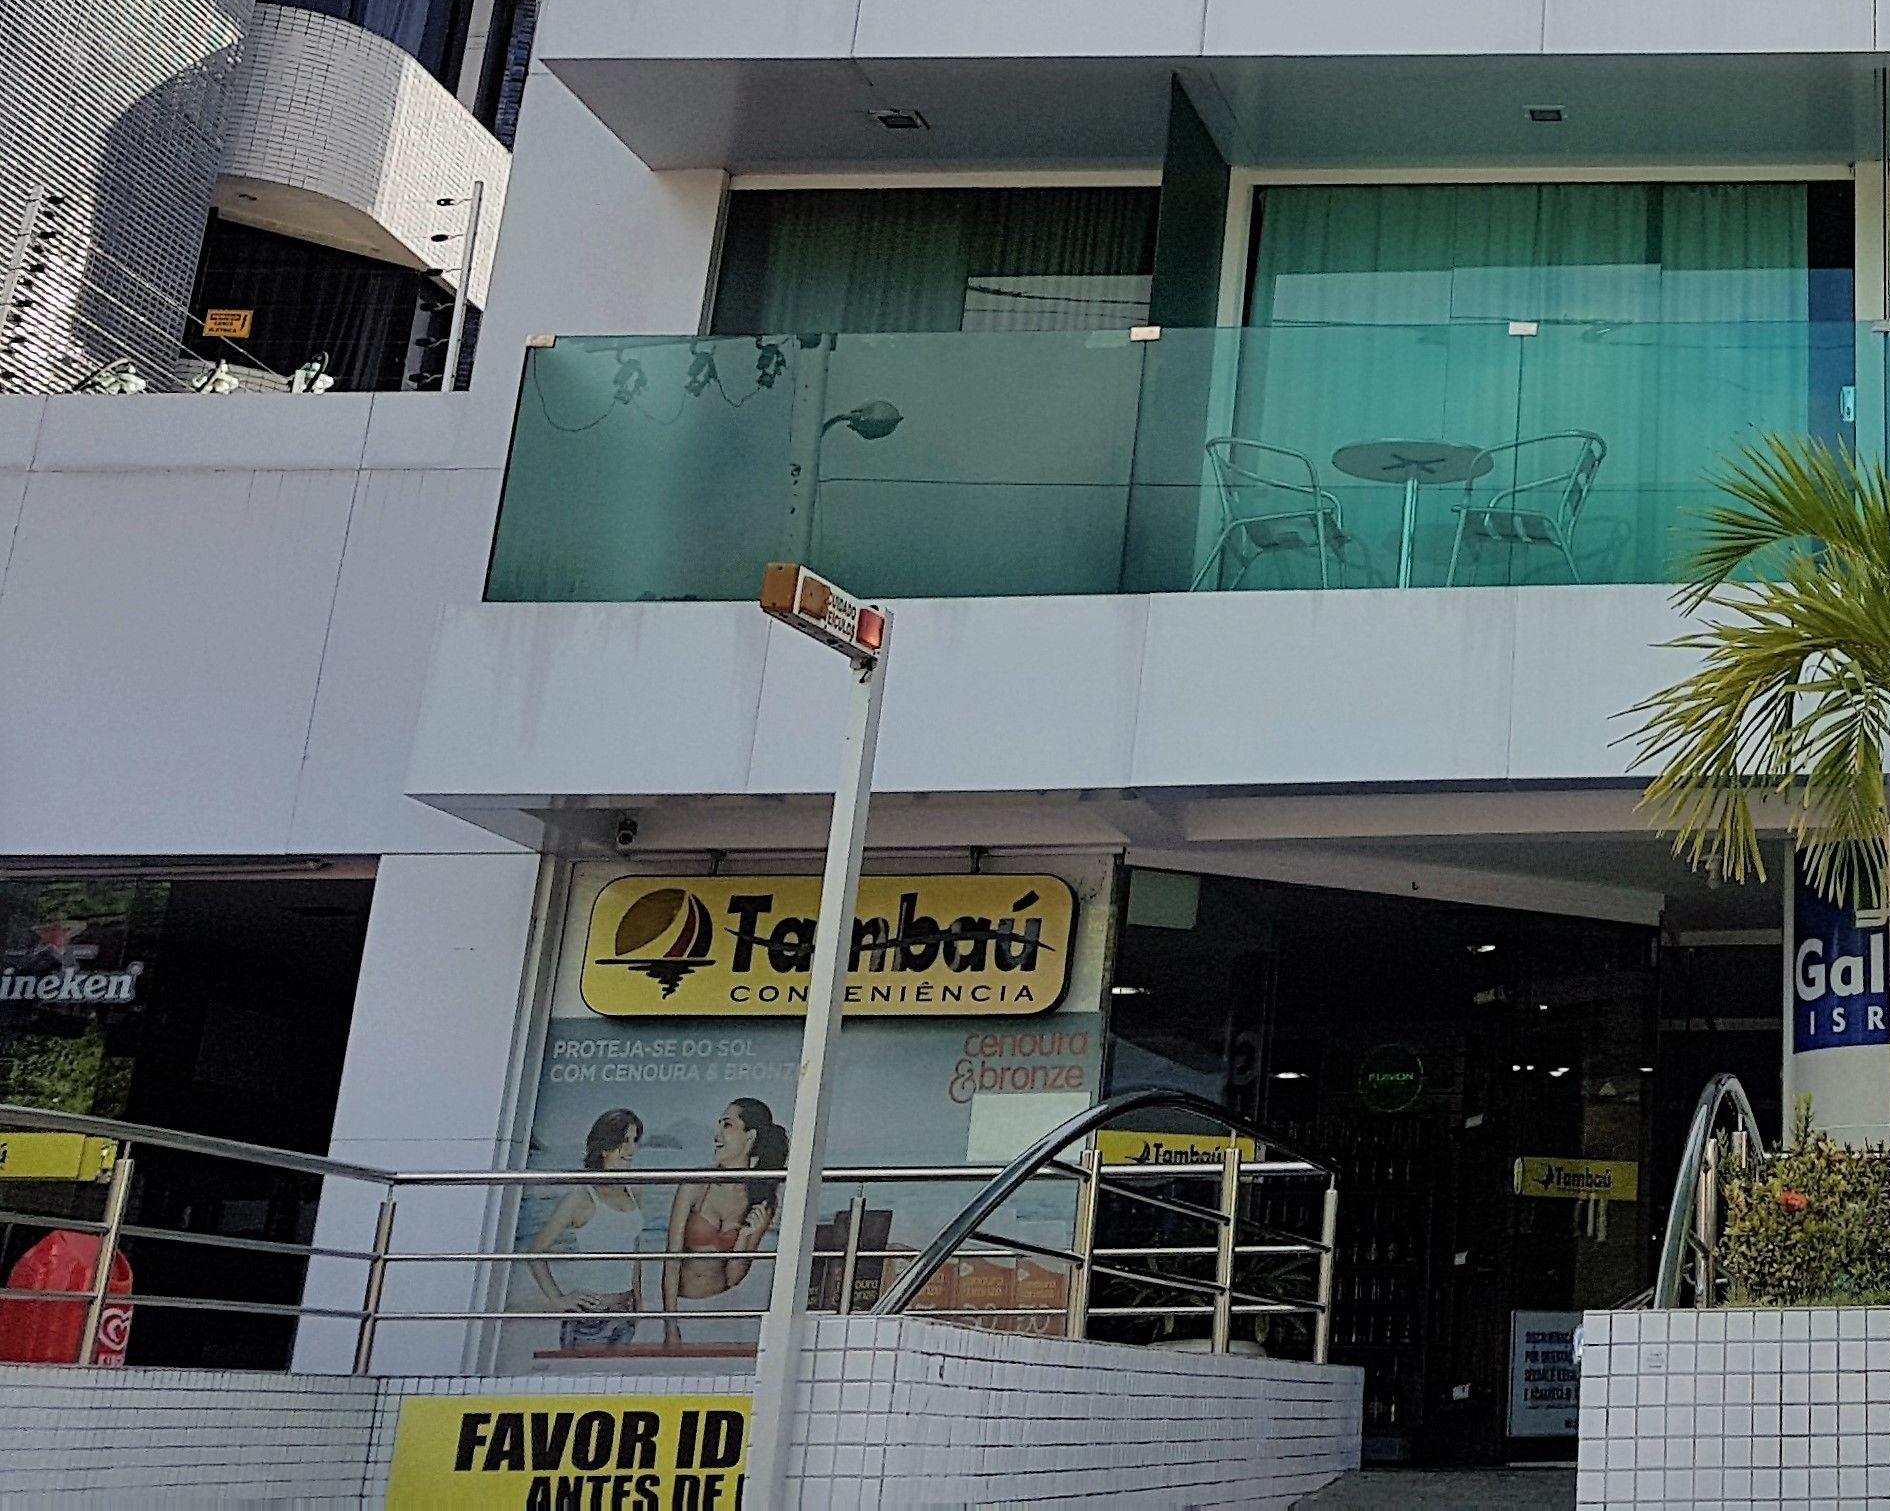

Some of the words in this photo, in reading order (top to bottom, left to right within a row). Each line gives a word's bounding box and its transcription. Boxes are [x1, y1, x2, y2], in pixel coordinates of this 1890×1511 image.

[729, 981, 1036, 1003] CONENIÊNCIA
[553, 1039, 678, 1059] PROTEJA-SE
[682, 1039, 712, 1057] DO
[717, 1039, 757, 1057] SOL
[964, 1031, 1088, 1058] cenoura
[550, 1063, 597, 1082] COM
[601, 1062, 700, 1082] CENOURA
[979, 1060, 1084, 1090] bronze
[454, 1411, 660, 1471] FAVOR
[674, 1410, 745, 1470] ID
[526, 1474, 660, 1511] ANTES
